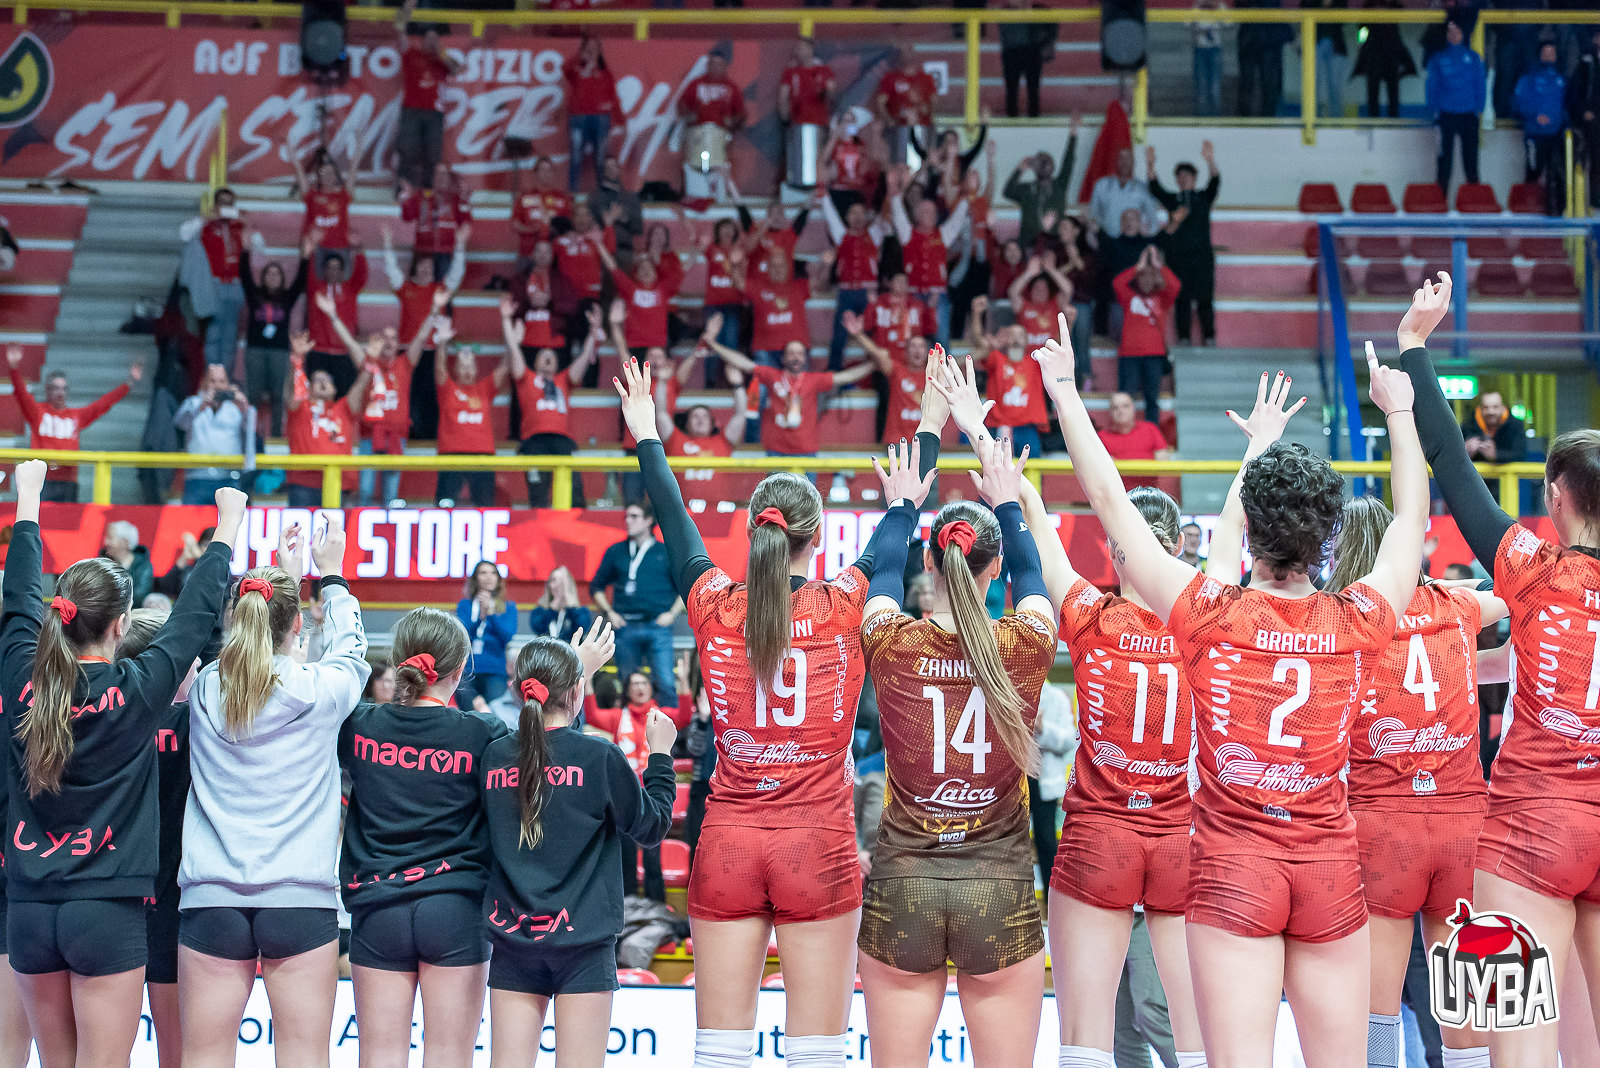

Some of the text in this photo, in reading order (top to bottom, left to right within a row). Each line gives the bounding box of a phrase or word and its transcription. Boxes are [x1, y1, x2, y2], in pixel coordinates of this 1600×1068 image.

[278, 43, 402, 79] BTO
[446, 47, 565, 84] SIZIO
[48, 91, 227, 180] SEM
[356, 509, 511, 579] STORE
[1256, 629, 1336, 654] BRACCHI
[1399, 613, 1433, 630] IVA
[752, 646, 808, 728] 19
[1128, 661, 1179, 745] 11
[1267, 657, 1312, 748] 2
[1402, 633, 1441, 712] 4
[353, 733, 473, 775] macron
[922, 685, 993, 775] 14
[486, 765, 585, 791] maon
[914, 778, 998, 808] Laica
